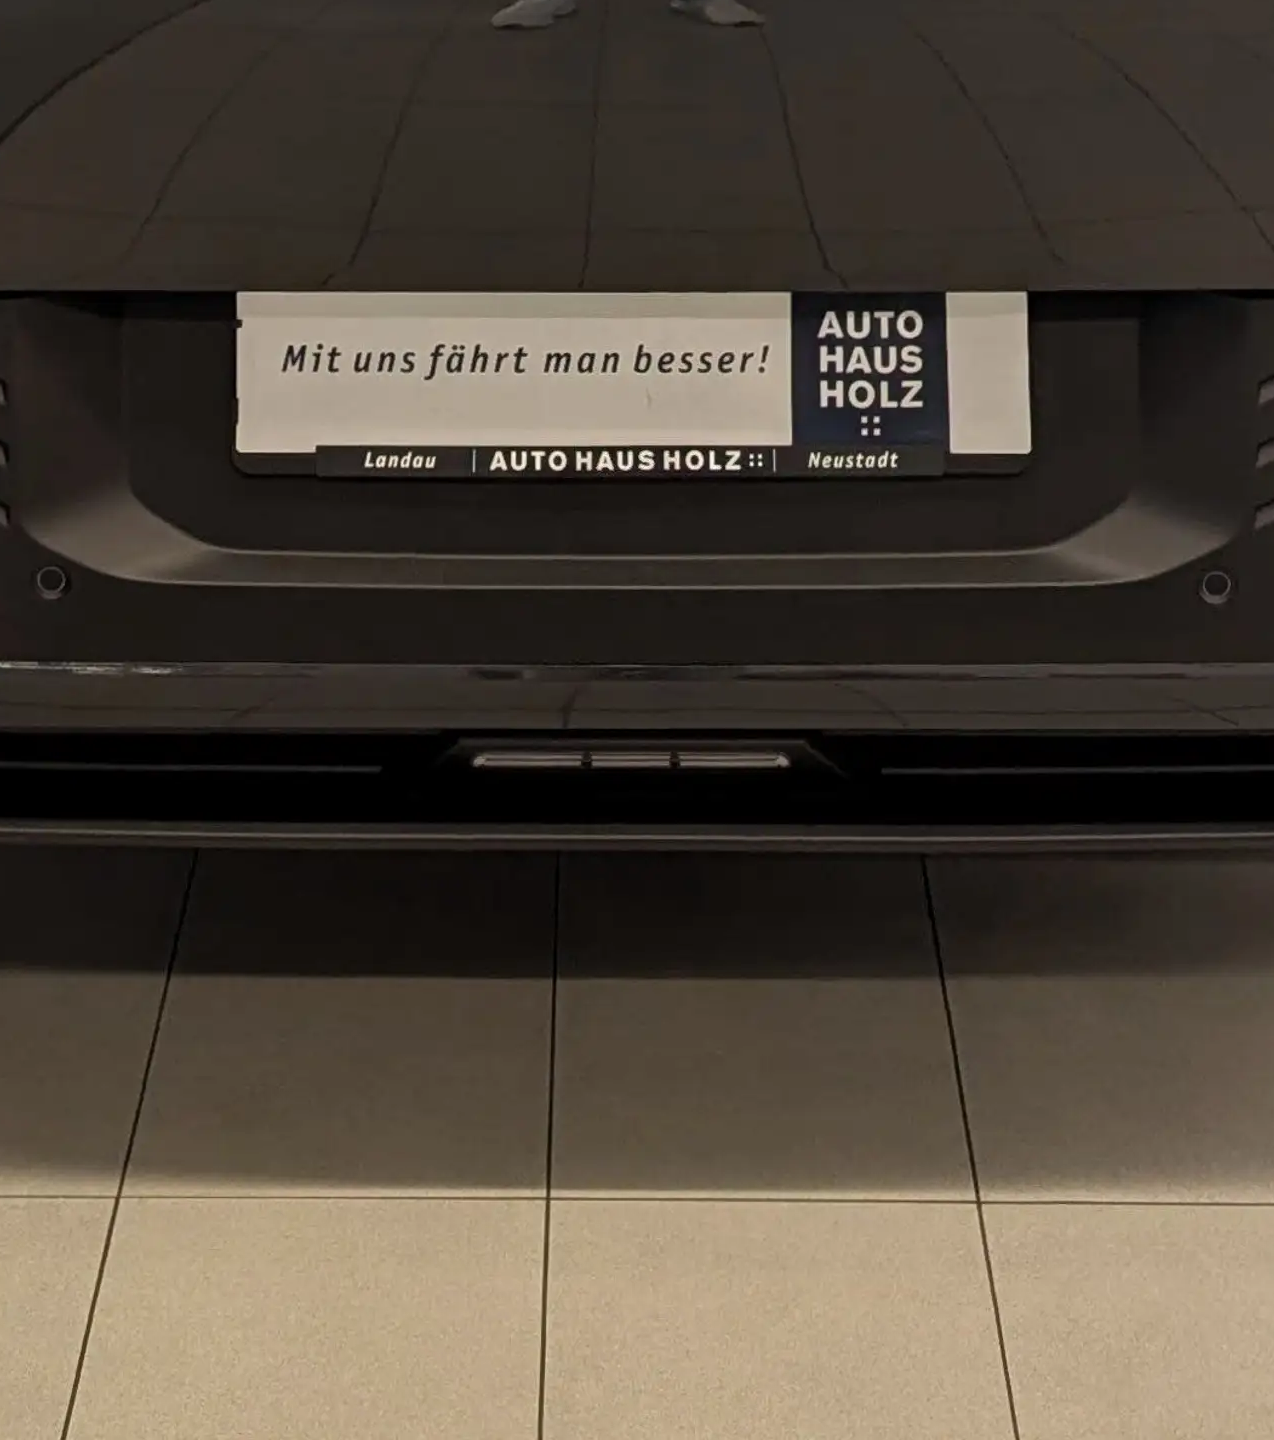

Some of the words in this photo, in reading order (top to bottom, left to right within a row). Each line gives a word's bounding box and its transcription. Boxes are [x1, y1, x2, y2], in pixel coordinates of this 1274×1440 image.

[817, 310, 924, 340] AUTO
[281, 343, 342, 373] Mit
[353, 351, 416, 373] uns
[423, 343, 528, 381] fährt
[543, 352, 621, 374] man
[633, 344, 770, 374] besser!
[819, 345, 924, 374] HAUS
[819, 380, 924, 408] HOLZ
[363, 451, 437, 469] Landau
[489, 450, 567, 471] AUTO
[575, 450, 656, 472] HAUS
[663, 450, 741, 471] HOLZ
[807, 450, 899, 469] Neustadt
